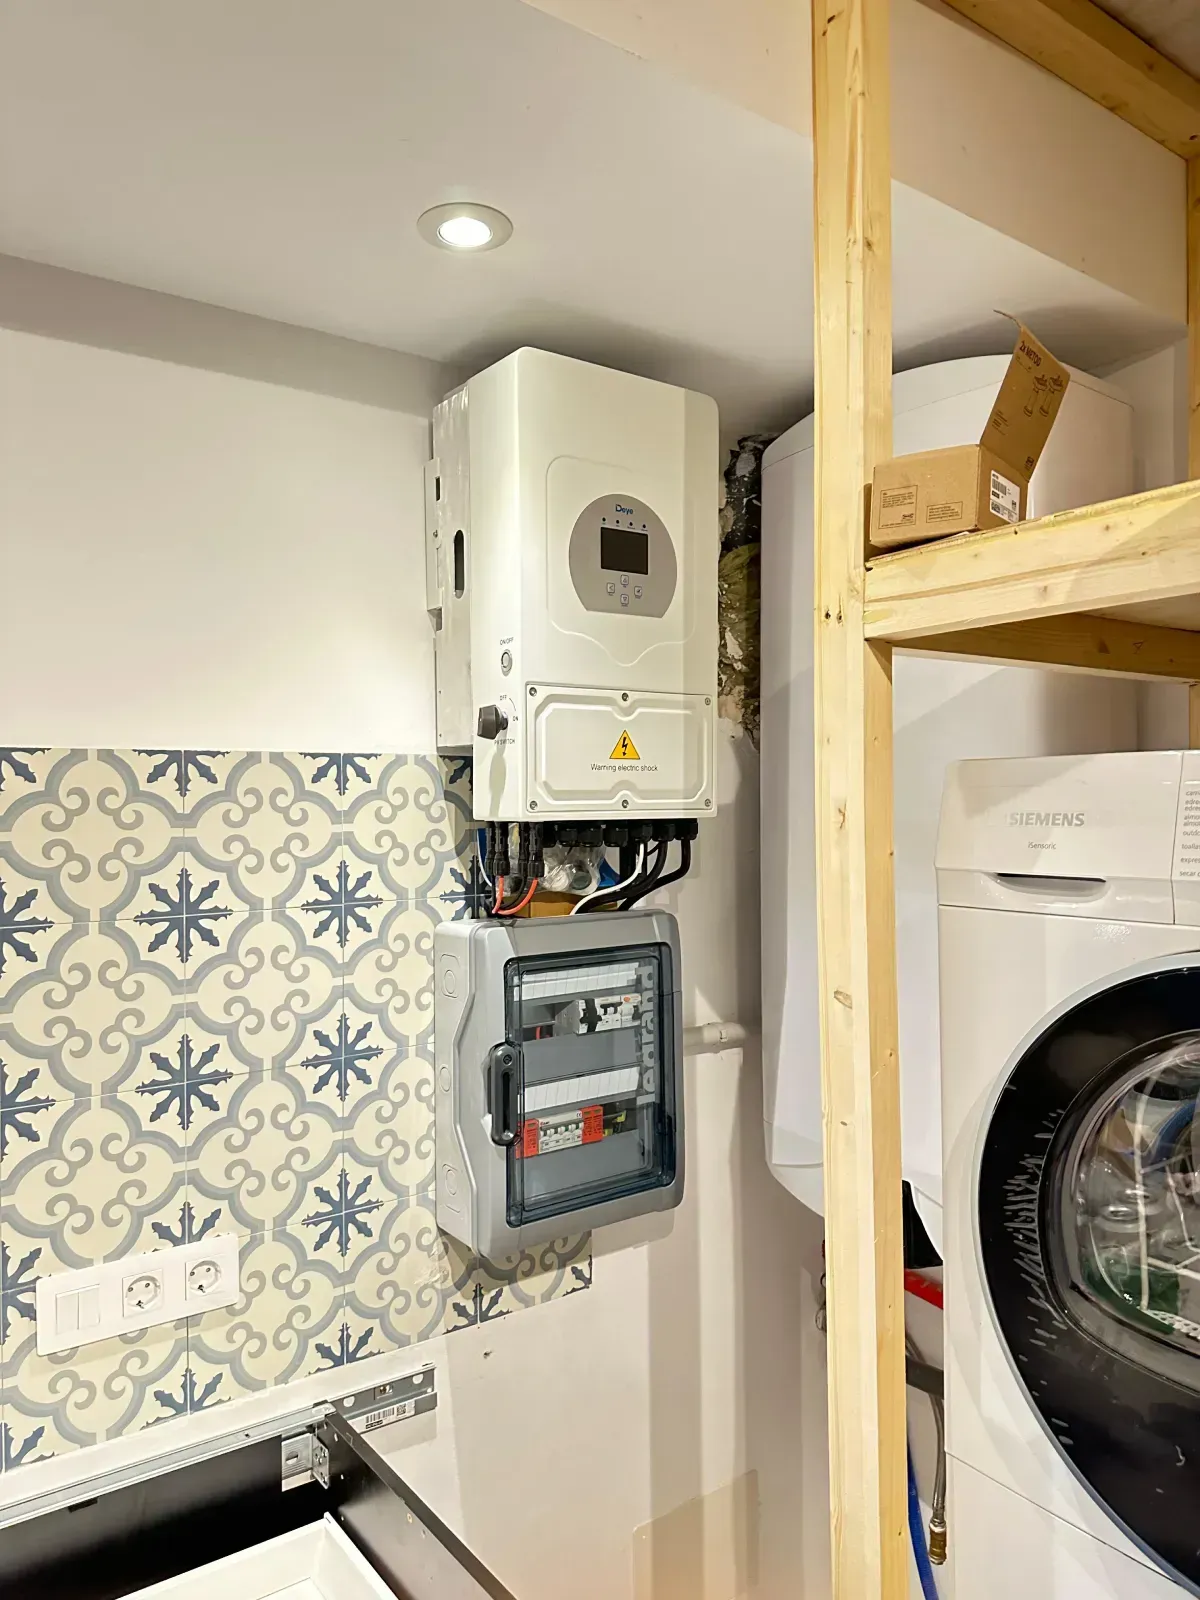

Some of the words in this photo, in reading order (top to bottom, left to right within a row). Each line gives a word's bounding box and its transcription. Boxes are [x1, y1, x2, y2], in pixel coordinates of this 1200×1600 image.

[615, 503, 634, 516] Deye
[499, 636, 514, 646] ON/OFF
[499, 694, 508, 702] OFF
[590, 763, 617, 773] Warning
[617, 764, 639, 772] electric
[641, 764, 658, 772] shock
[1009, 812, 1085, 827] SIEMENS
[1028, 841, 1057, 850] iSensoric
